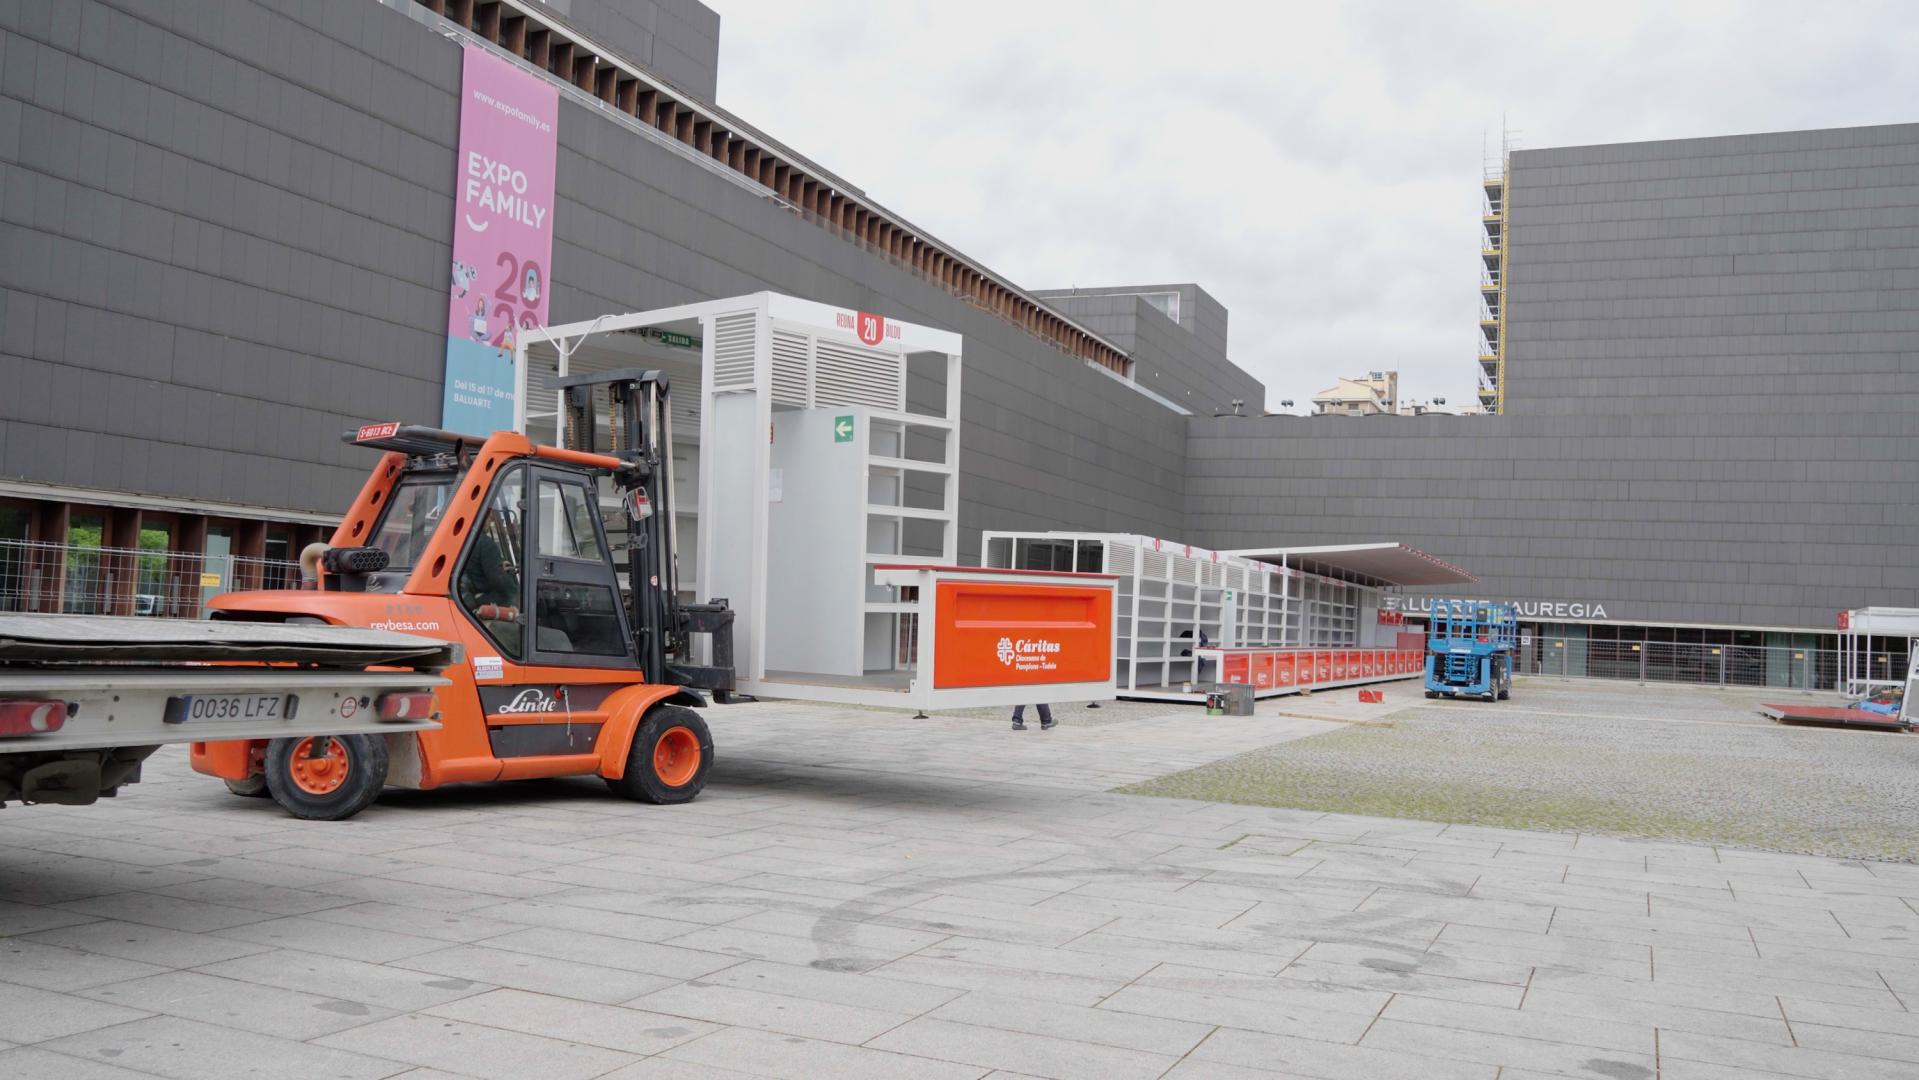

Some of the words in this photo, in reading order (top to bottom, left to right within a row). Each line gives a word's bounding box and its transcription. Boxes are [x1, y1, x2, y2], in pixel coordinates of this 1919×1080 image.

[473, 89, 550, 132] www.expofamily.es
[468, 151, 527, 194] EXPO
[466, 178, 546, 229] FAMILY
[494, 251, 542, 310] 20
[864, 317, 877, 341] 20
[454, 393, 492, 409] BALUARTE
[370, 619, 439, 631] reybesa.com
[1015, 639, 1060, 653] Cáritas
[192, 698, 240, 719] 0036
[245, 697, 280, 717] LFZ
[498, 689, 556, 714] Linde
